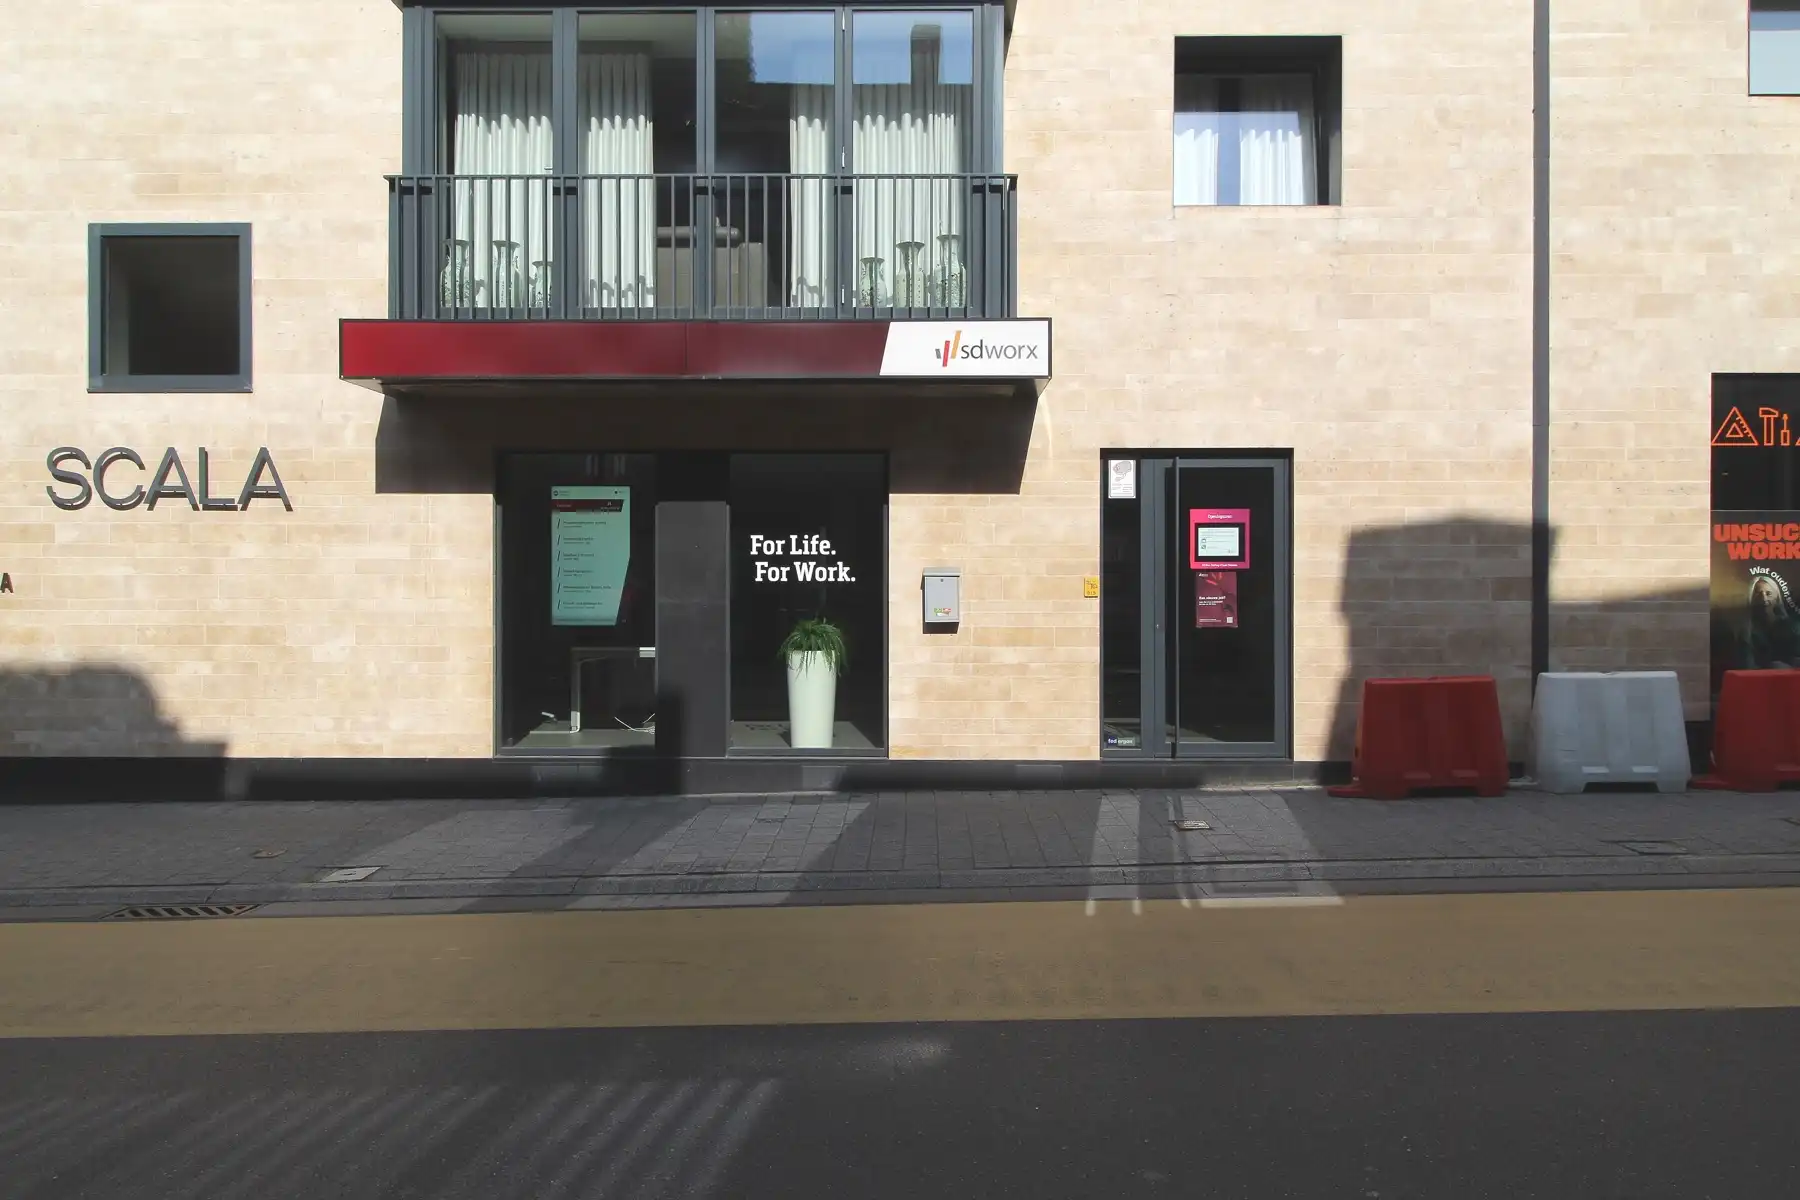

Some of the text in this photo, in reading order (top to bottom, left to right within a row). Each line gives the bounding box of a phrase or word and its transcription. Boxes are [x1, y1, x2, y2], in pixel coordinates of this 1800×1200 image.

[960, 339, 1038, 359] sdworx
[46, 446, 294, 512] SCALA
[750, 534, 836, 555] For Life.
[1727, 541, 1800, 560] WORK
[755, 561, 856, 582] For Work.
[1749, 565, 1770, 576] Wat
[0, 572, 14, 594] A
